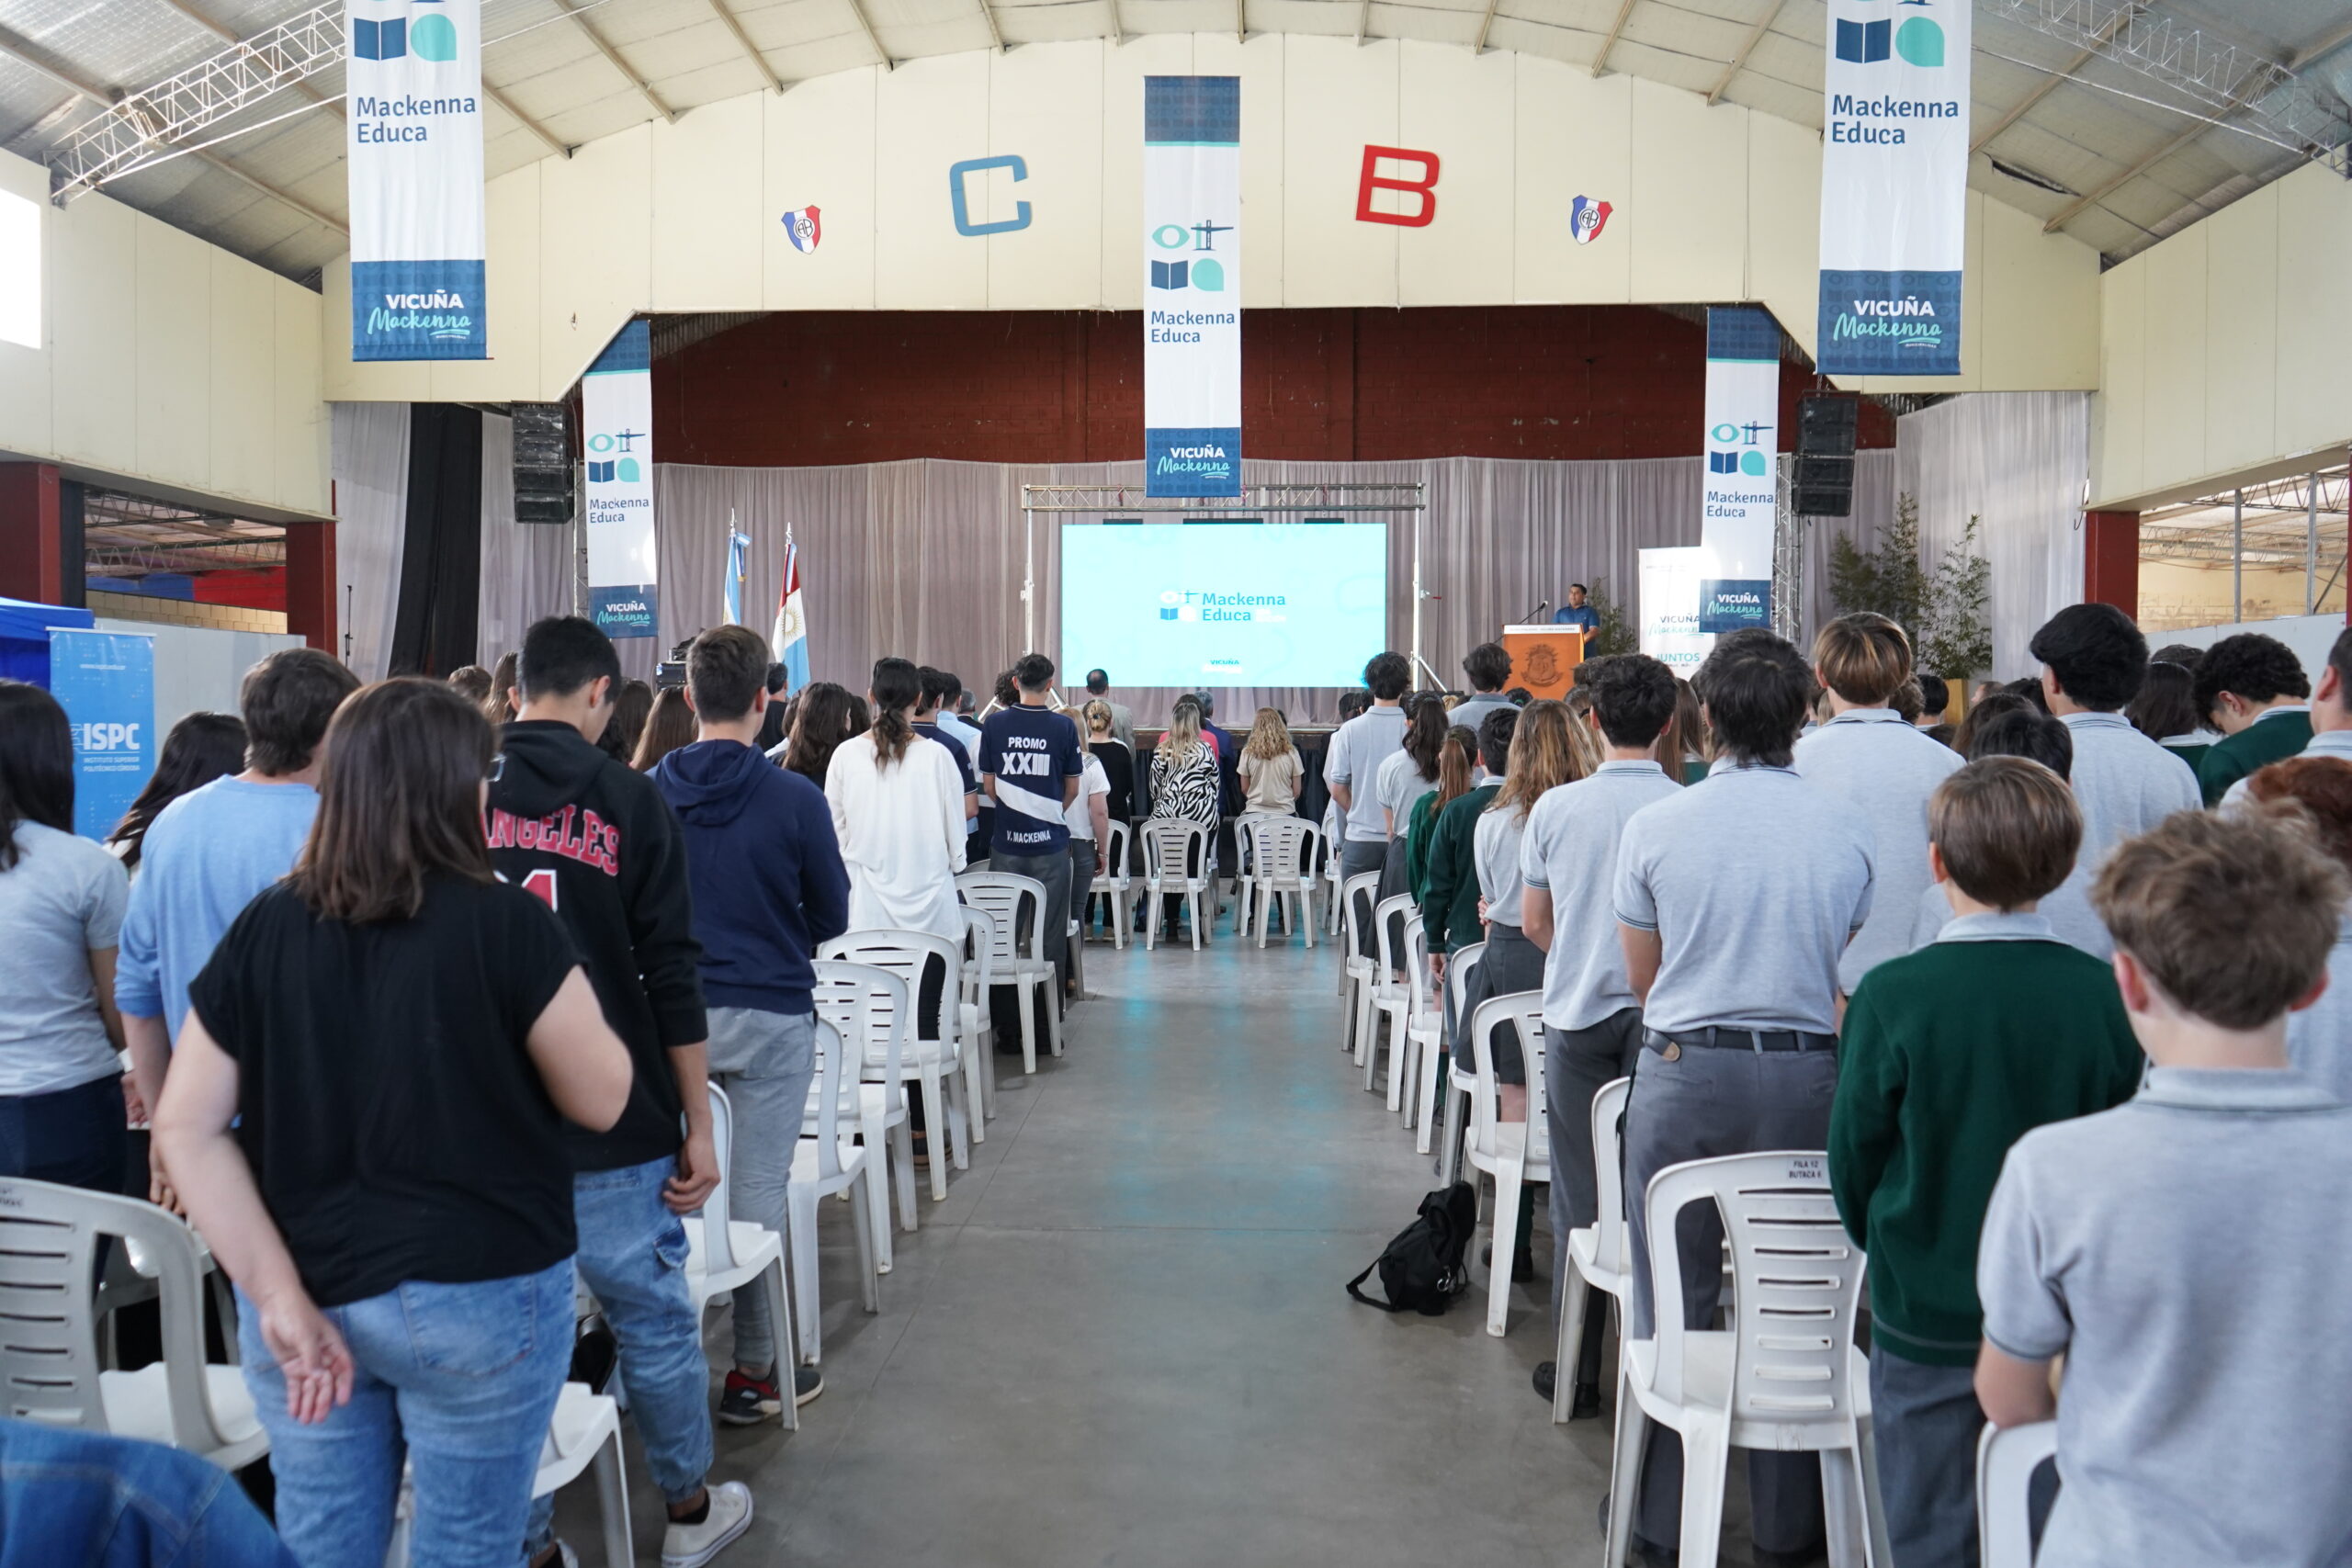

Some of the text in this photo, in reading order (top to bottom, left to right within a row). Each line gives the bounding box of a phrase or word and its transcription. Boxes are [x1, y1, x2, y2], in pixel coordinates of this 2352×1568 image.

[356, 95, 476, 117] Mackenna
[1832, 95, 1959, 118] Mackenna
[357, 121, 427, 143] Educa
[1832, 121, 1905, 144] Educa
[950, 144, 1440, 236] C B
[386, 288, 464, 309] VICUÑA
[1854, 296, 1935, 316] VICUÑA
[368, 307, 471, 334] Mackenna
[1151, 310, 1235, 324] Mackenna
[1833, 312, 1942, 341] Mackenna
[1151, 328, 1201, 343] Educa
[1170, 445, 1225, 458] VICUÑA
[1157, 456, 1230, 475] Mackenna
[590, 497, 650, 510] Mackenna
[1707, 491, 1774, 503] Mackenna
[590, 512, 625, 524] Educa
[1707, 505, 1746, 517] Educa
[1203, 592, 1286, 605] Mackenna
[1717, 592, 1760, 604] VICUÑA
[606, 601, 647, 612] VICUÑA
[1706, 601, 1763, 616] Mackenna
[596, 610, 650, 626] Mackenna
[1203, 608, 1251, 621] Educa
[84, 723, 140, 750] ISPC
[1008, 737, 1046, 750] PROMO
[1001, 752, 1050, 776] XXIII
[1006, 830, 1051, 843] V. MACKENNA
